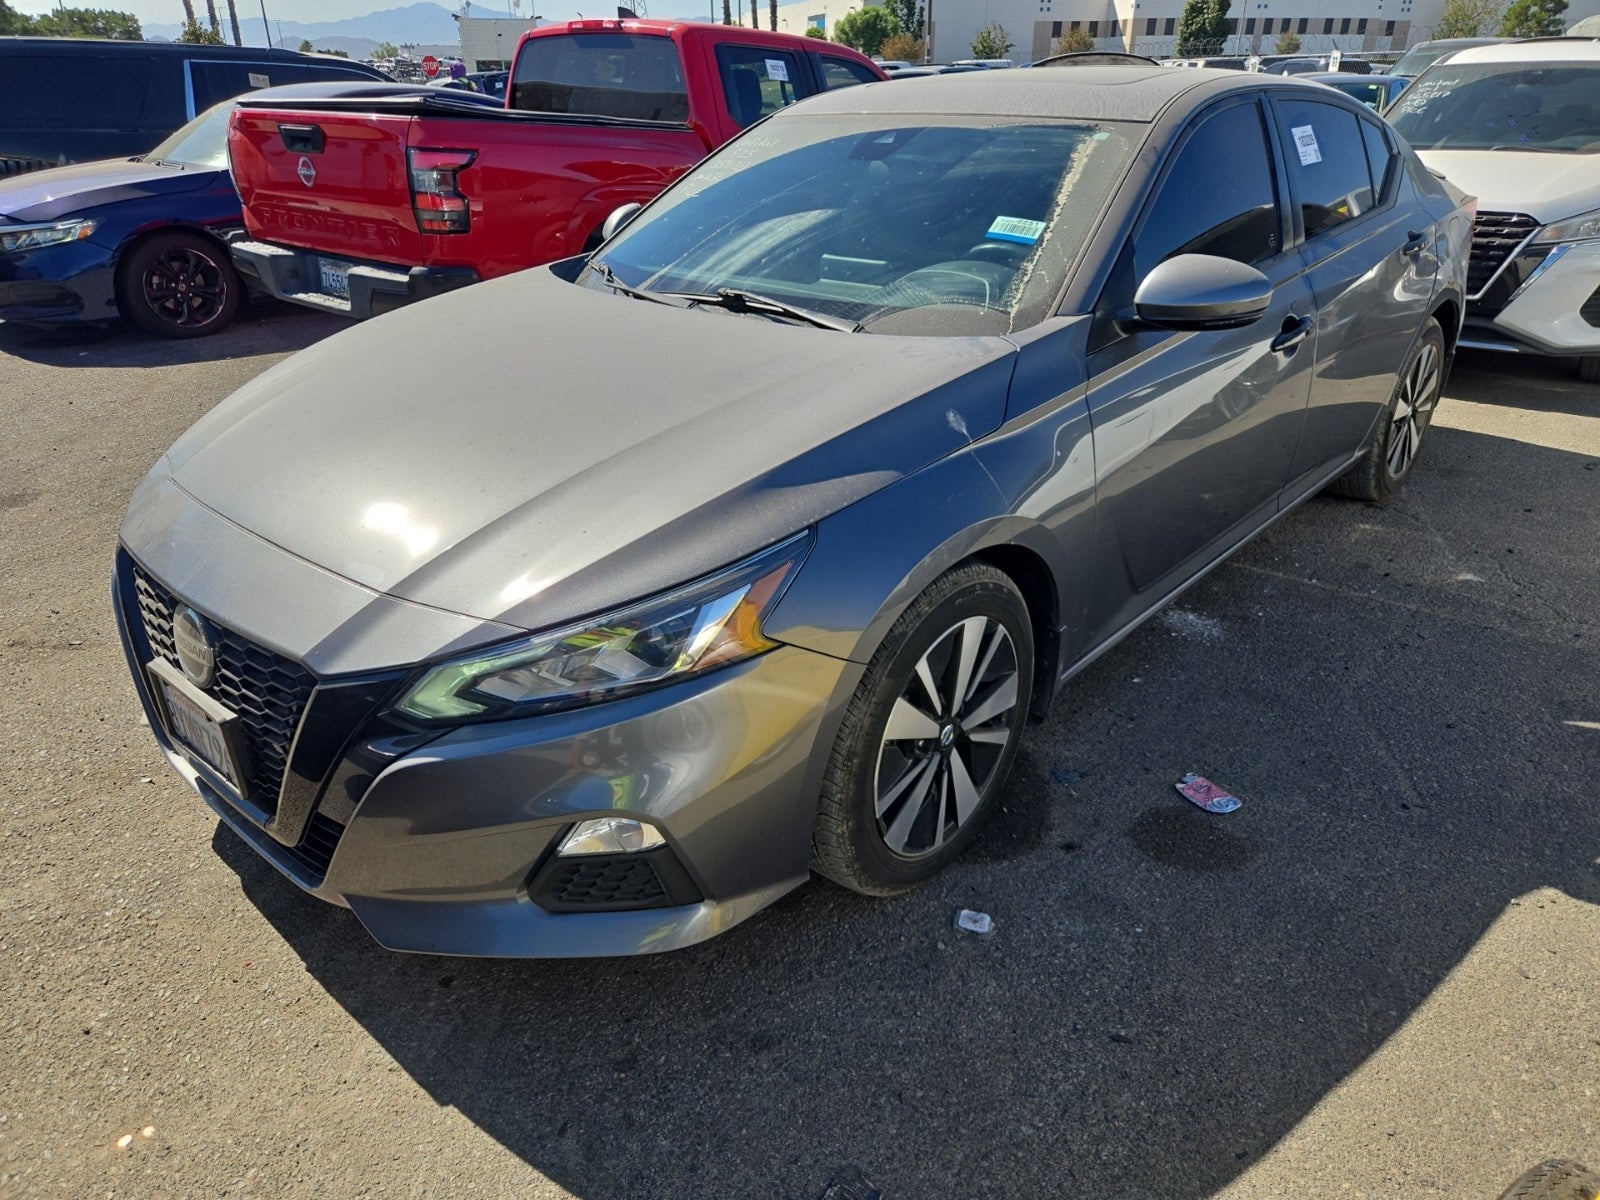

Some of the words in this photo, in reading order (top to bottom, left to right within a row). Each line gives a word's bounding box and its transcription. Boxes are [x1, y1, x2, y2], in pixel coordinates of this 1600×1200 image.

[423, 61, 438, 70] STOP
[258, 206, 401, 246] FRONTIER
[177, 633, 208, 660] NISSAN
